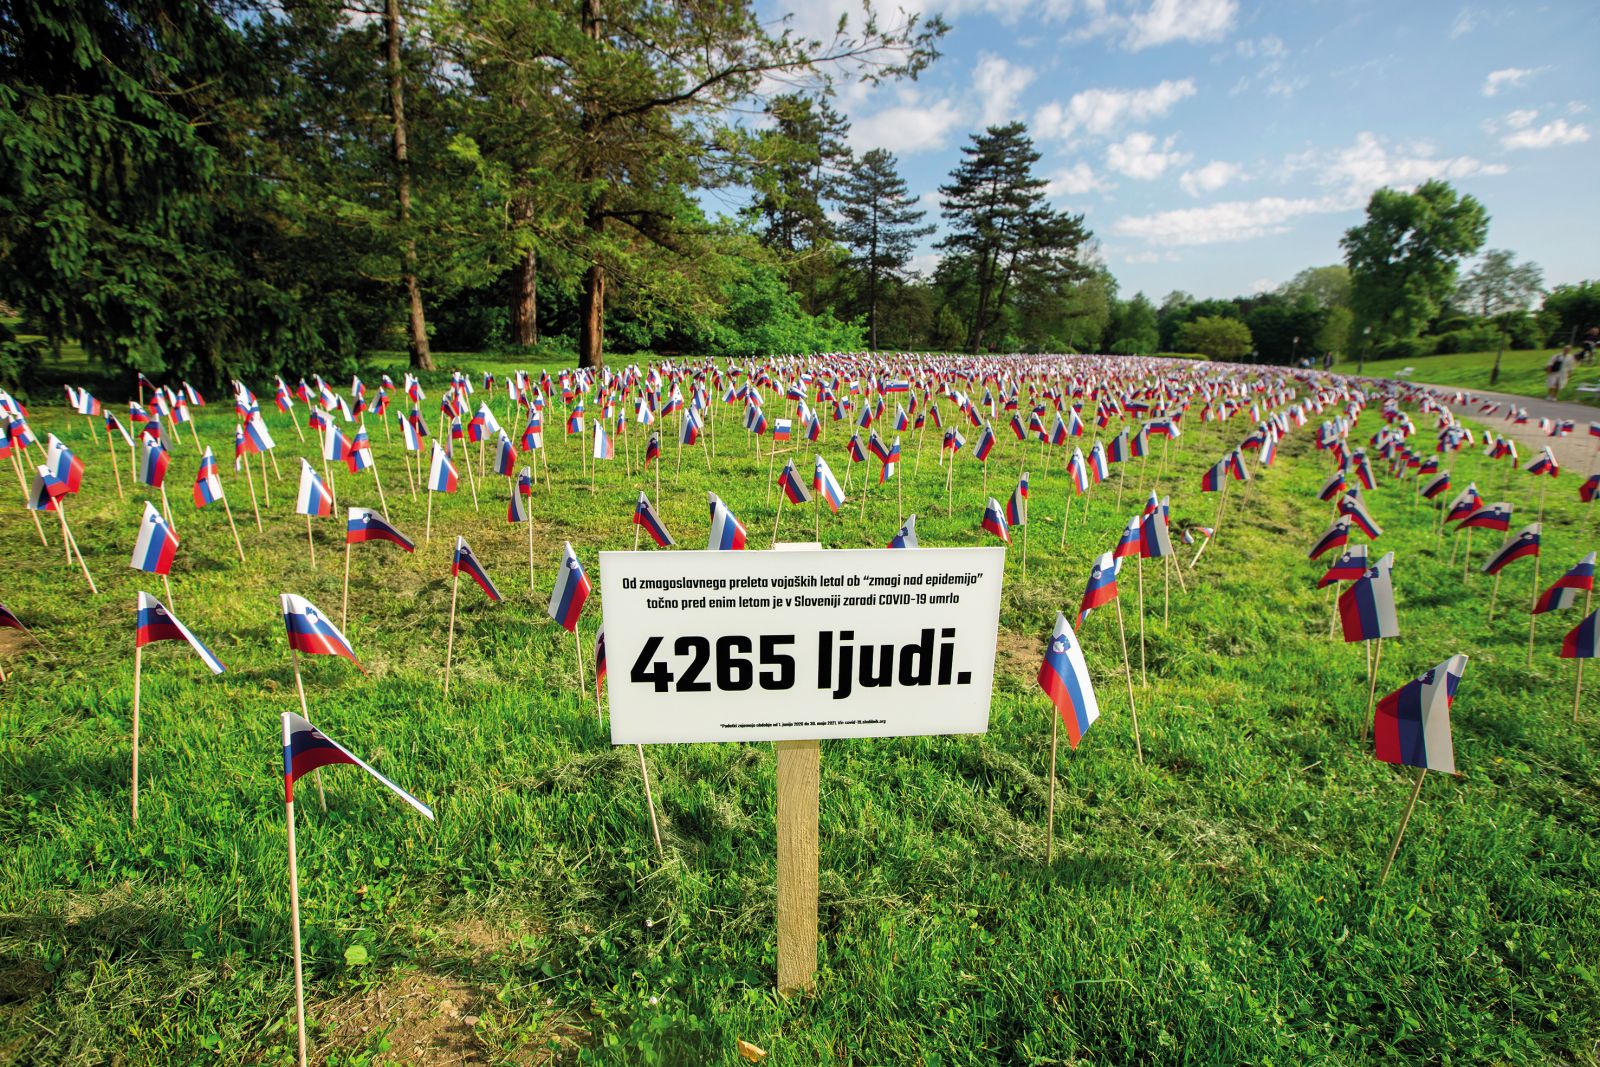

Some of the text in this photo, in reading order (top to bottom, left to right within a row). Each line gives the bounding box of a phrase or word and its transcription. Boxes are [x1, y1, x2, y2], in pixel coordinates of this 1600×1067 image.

[622, 576, 637, 590] Od
[639, 576, 727, 592] zmagoslavnega
[729, 575, 769, 591] preleta
[770, 575, 818, 590] vojaških
[819, 574, 845, 588] letal
[846, 574, 861, 587] ob
[862, 573, 901, 588] “zmagi
[903, 573, 924, 586] nad
[646, 592, 960, 611] točno pred enim letom je v Sloveniji zaradi COVID-19 umrlo
[631, 628, 971, 699] 4265 ljudi.
